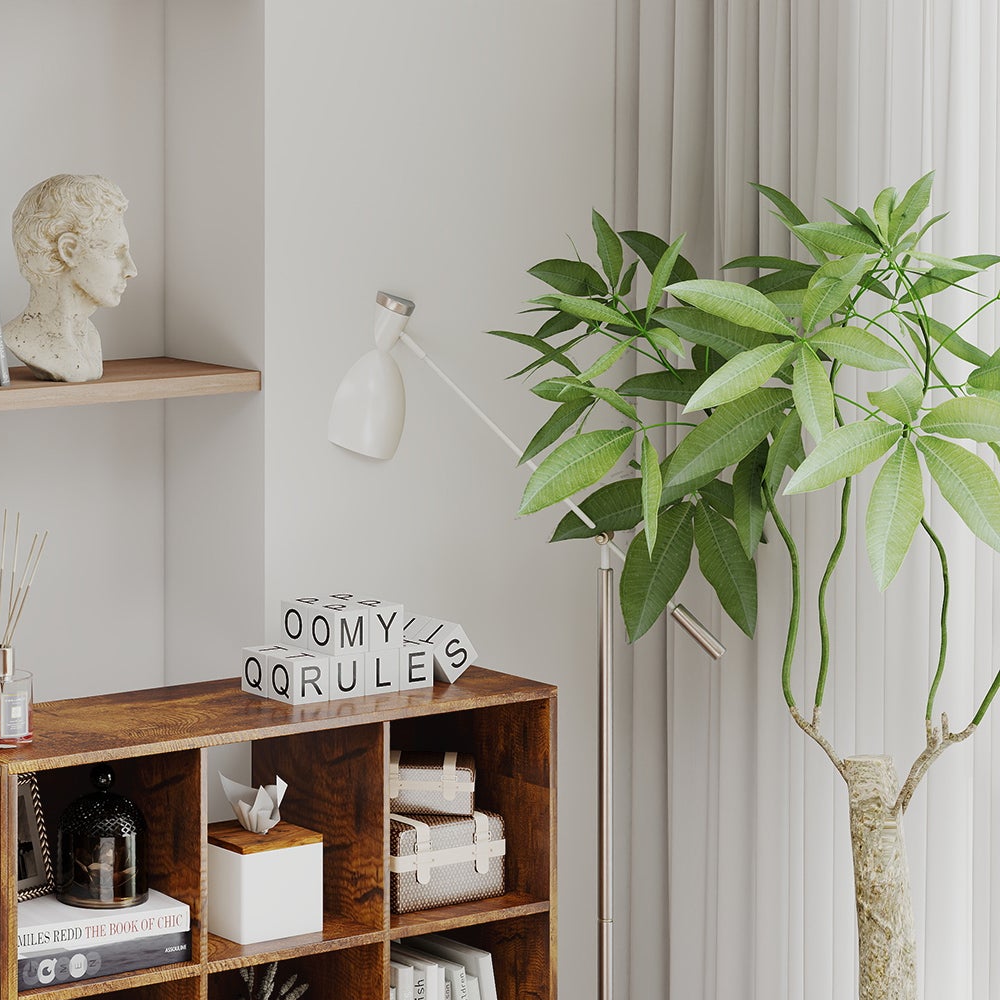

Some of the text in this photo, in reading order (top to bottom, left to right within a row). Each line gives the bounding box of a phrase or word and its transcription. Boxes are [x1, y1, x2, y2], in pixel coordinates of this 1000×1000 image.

[53, 926, 82, 943] REDD
[85, 924, 107, 939] THE
[109, 919, 139, 935] BOOK
[141, 917, 154, 932] OF
[157, 914, 183, 929] CHIC
